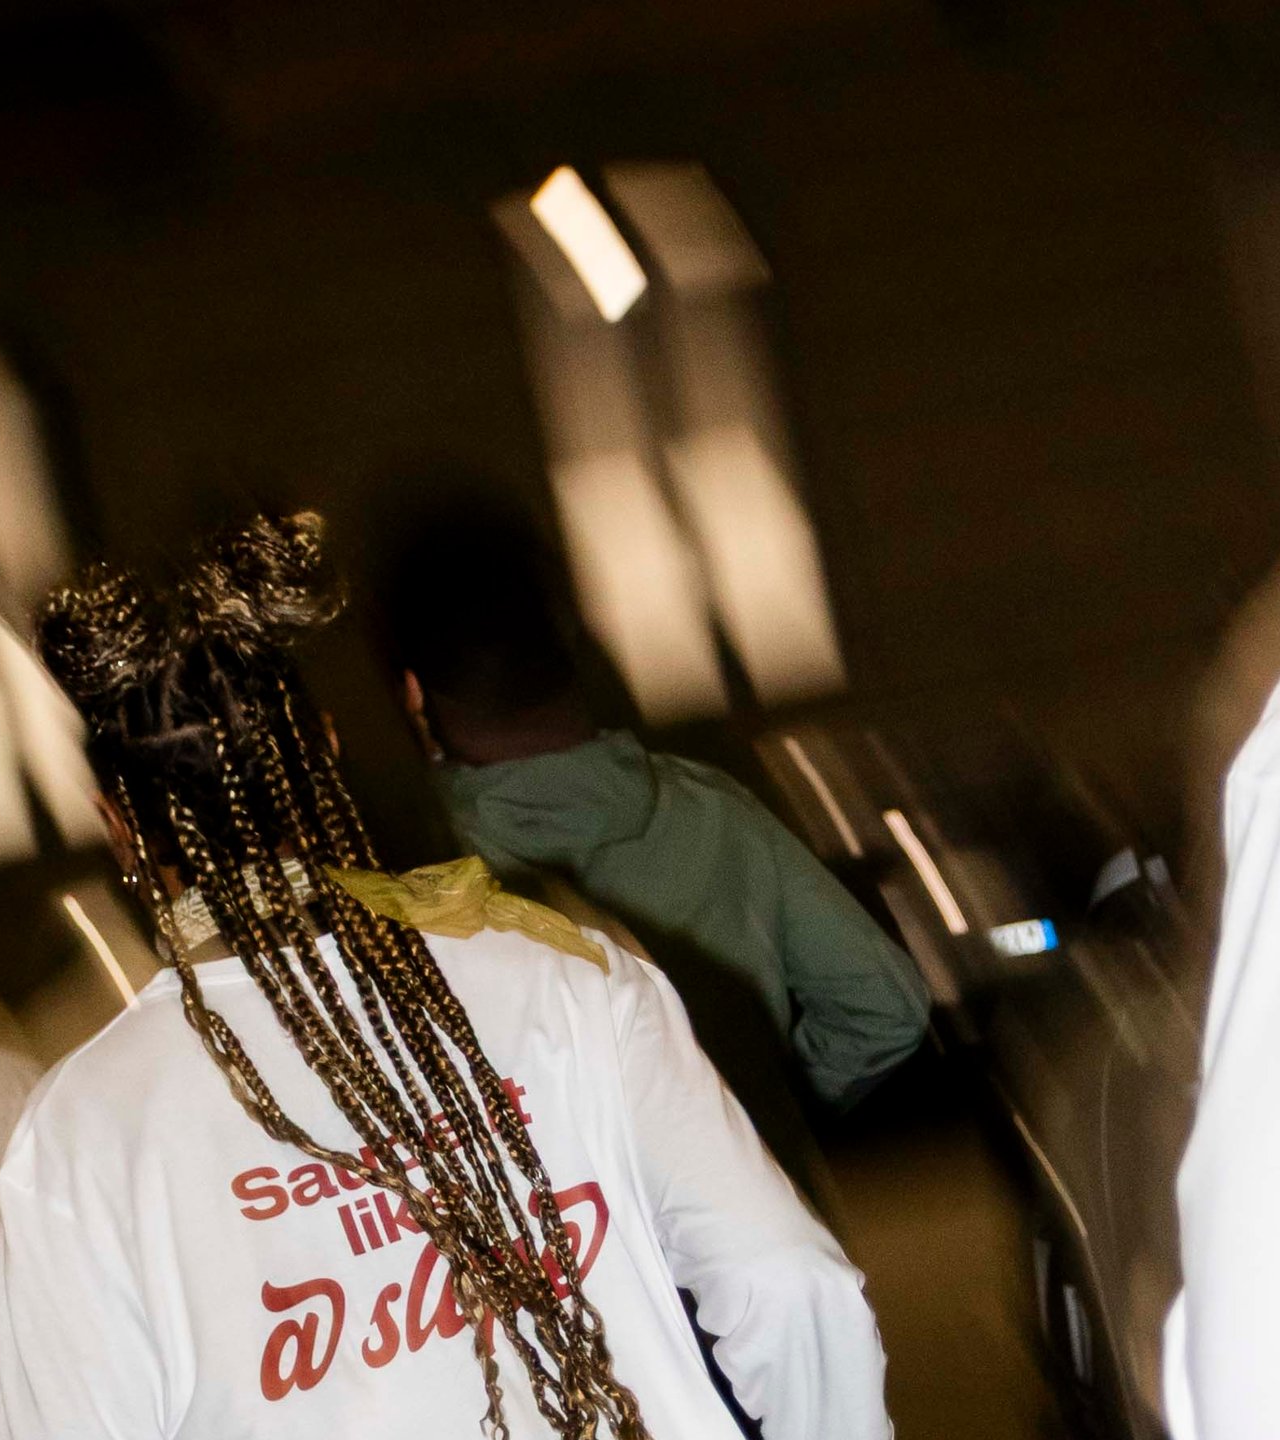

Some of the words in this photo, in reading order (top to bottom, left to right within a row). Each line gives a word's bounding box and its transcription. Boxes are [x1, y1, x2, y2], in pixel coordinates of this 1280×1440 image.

[482, 1076, 534, 1135] t
[260, 1277, 346, 1402] a
[361, 1180, 610, 1369] sloe
